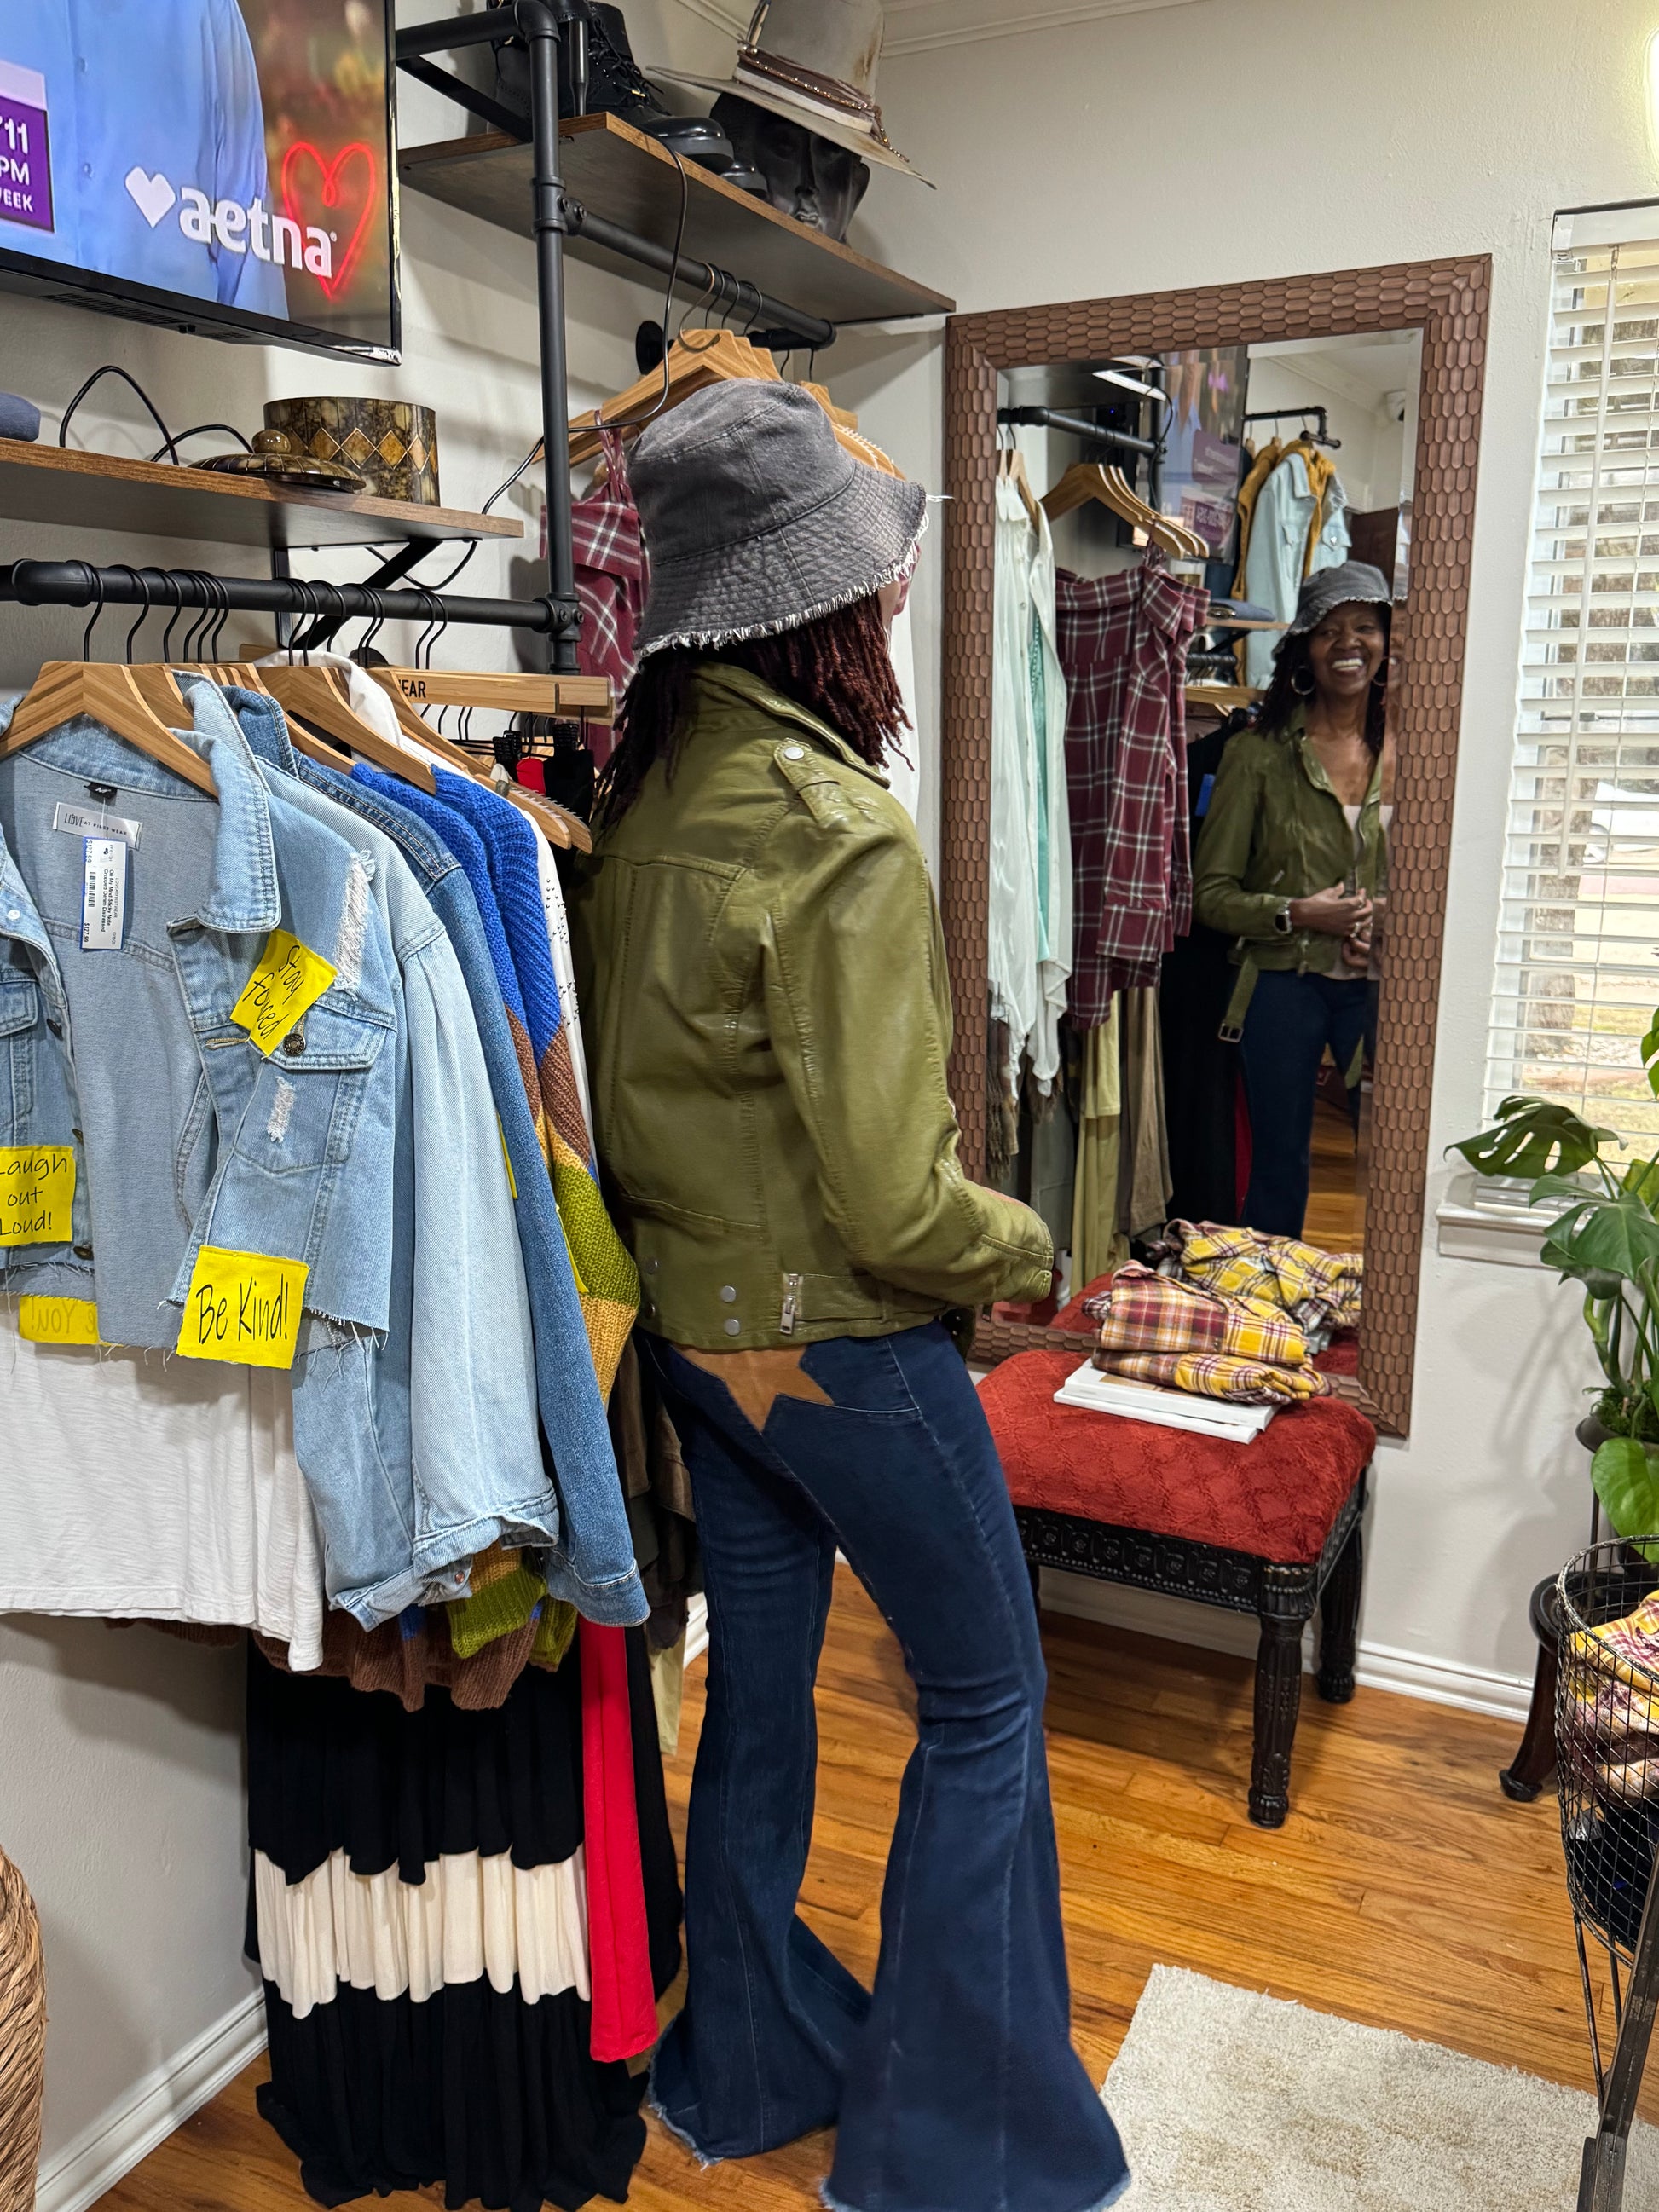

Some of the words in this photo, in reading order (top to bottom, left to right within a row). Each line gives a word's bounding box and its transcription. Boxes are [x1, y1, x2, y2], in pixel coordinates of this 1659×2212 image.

[0, 116, 28, 154] 11
[0, 187, 33, 213] EEK
[180, 186, 333, 279] aetna
[398, 679, 426, 698] EAR
[278, 944, 304, 1006] Stay
[7, 1186, 43, 1207] out
[0, 1210, 52, 1236] Loud!
[195, 1283, 228, 1345] Be
[237, 1273, 289, 1342] Kind!
